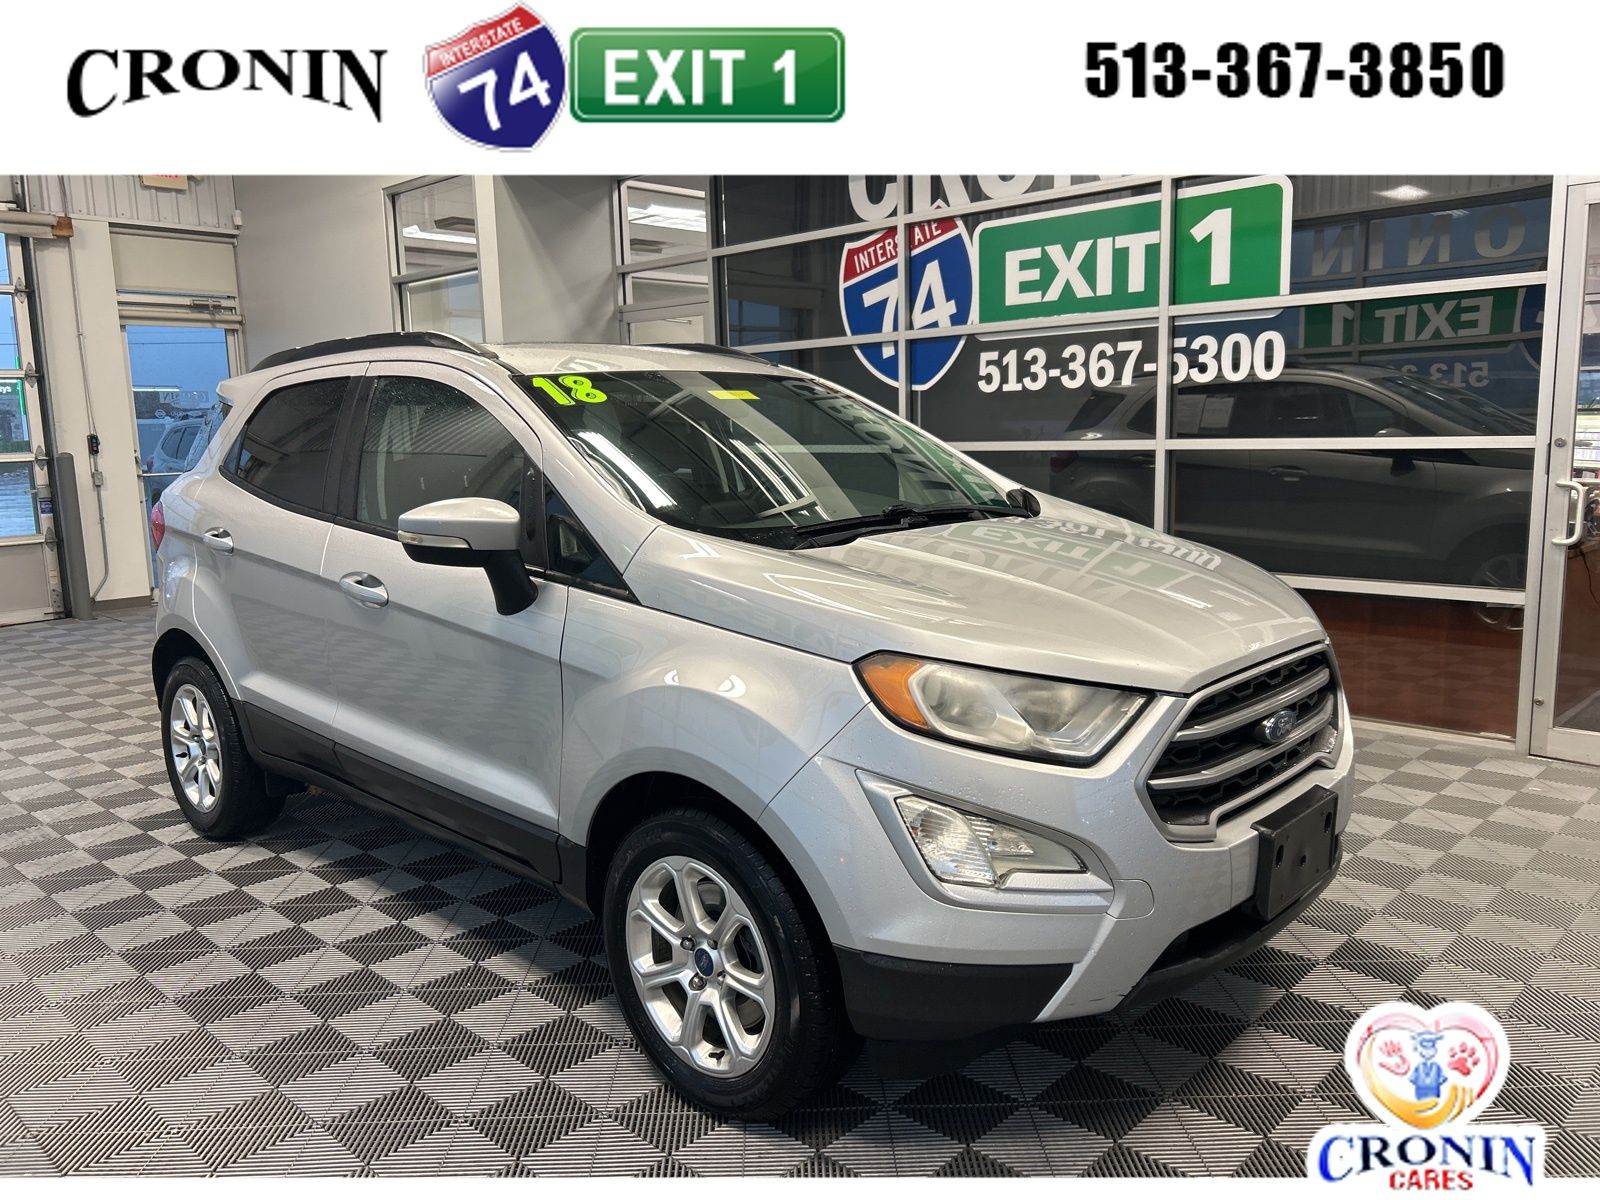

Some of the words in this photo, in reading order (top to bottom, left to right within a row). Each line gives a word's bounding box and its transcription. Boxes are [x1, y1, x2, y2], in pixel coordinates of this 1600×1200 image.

[853, 216, 942, 274] INTERSATE
[1005, 230, 1161, 307] EXIT
[1189, 207, 1232, 287] 1
[862, 259, 958, 360] 74
[532, 375, 608, 406] 18
[977, 330, 1285, 394] 513-367-5300
